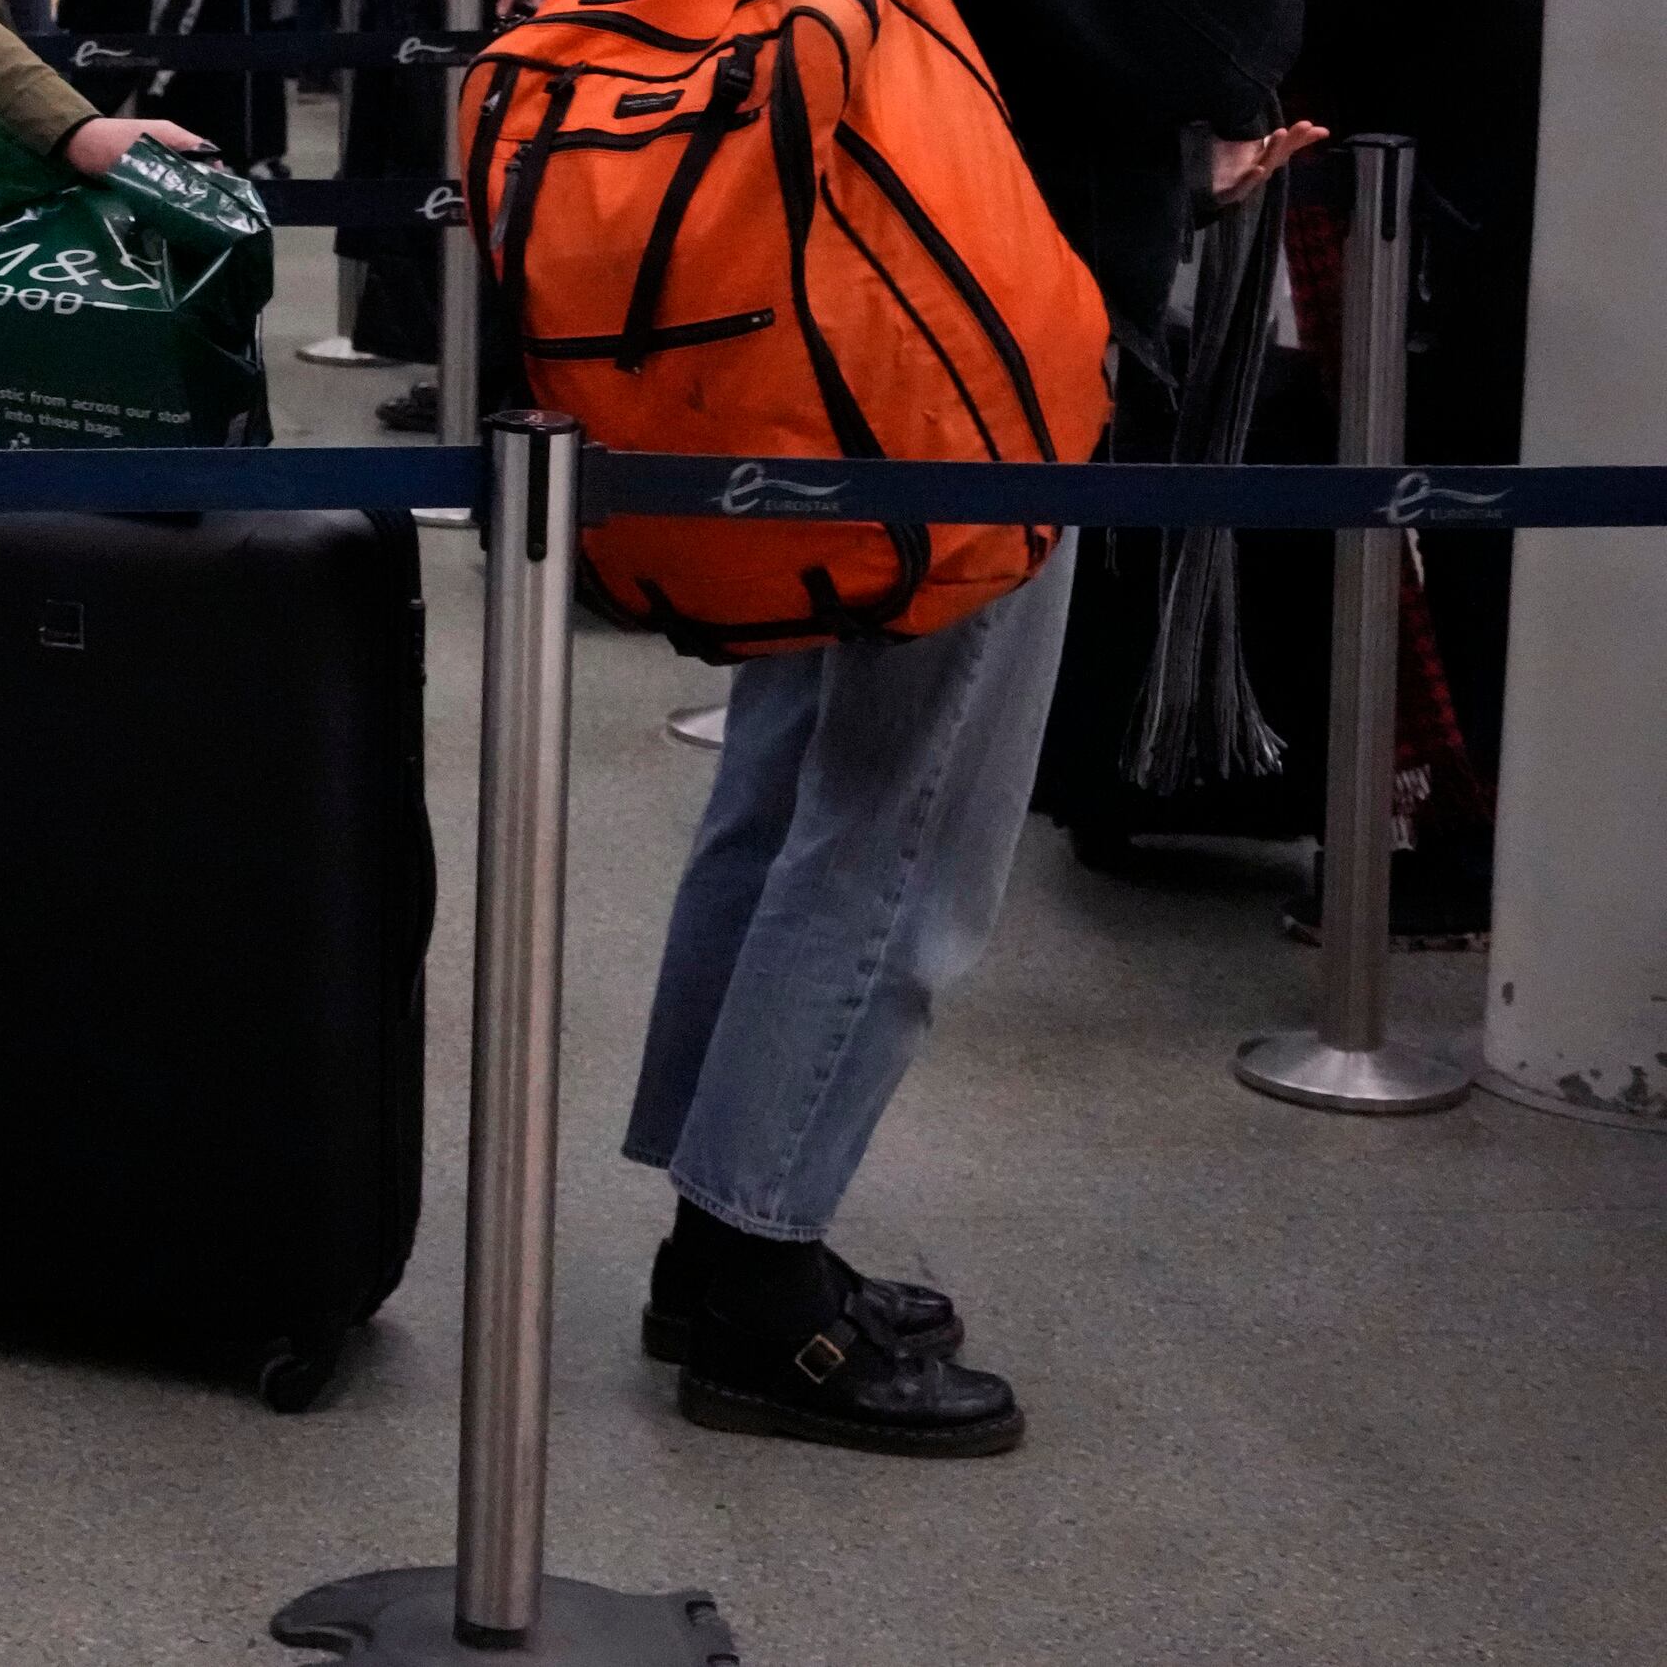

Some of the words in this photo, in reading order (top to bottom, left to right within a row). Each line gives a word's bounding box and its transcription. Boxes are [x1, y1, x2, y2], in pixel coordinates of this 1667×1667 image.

[30, 390, 67, 407] from
[72, 398, 121, 416] across
[126, 405, 152, 420] our
[4, 407, 34, 424] into
[38, 412, 79, 431] these
[764, 500, 841, 513] EUROSTAR
